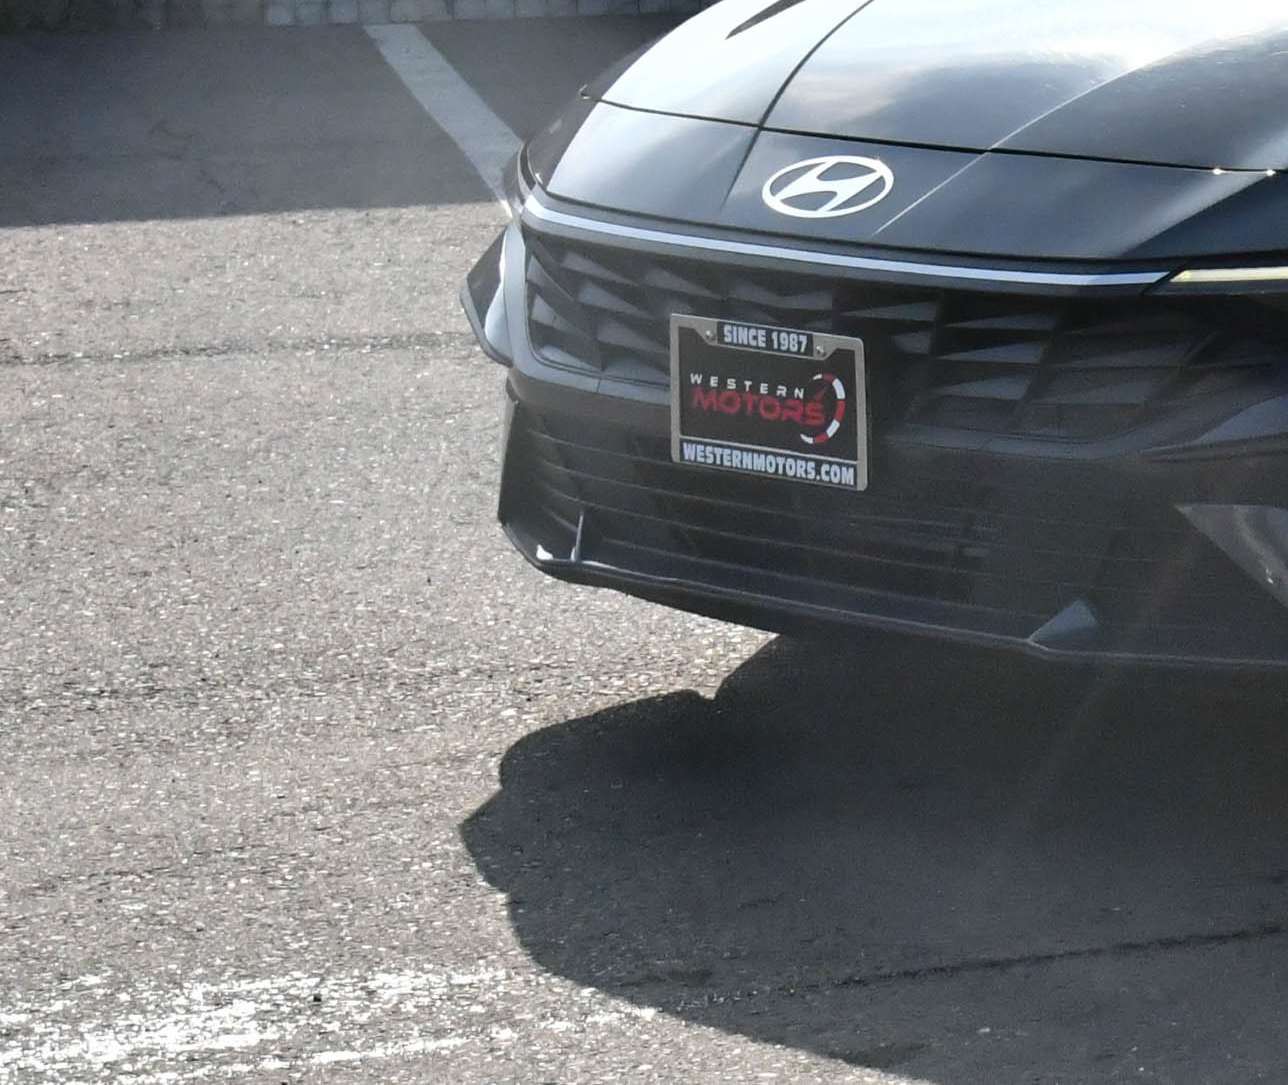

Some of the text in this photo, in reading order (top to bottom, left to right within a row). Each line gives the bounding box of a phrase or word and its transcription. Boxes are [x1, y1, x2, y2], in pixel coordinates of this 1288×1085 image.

[723, 324, 808, 353] SINCE 1987
[689, 373, 805, 399] WESTERN
[691, 386, 826, 427] MOTORS
[682, 442, 855, 486] WESTERNMOTORS.COM
